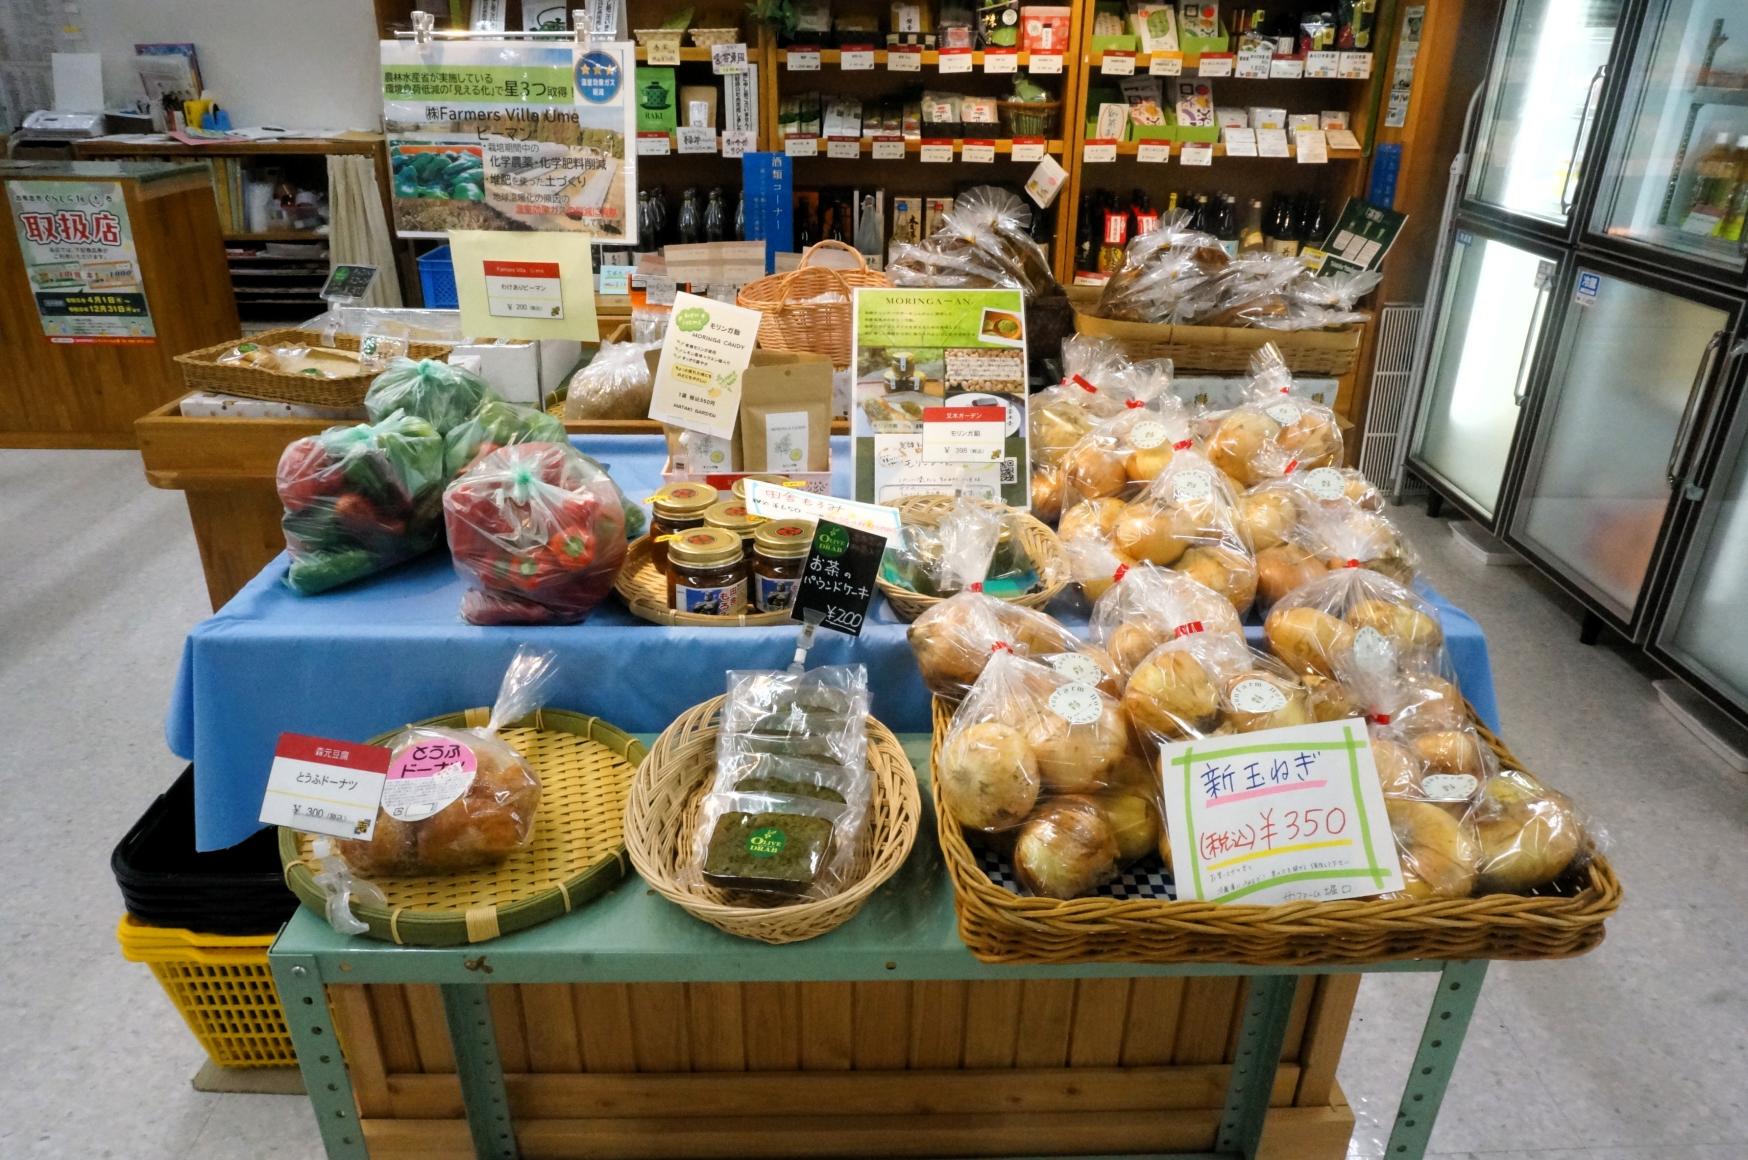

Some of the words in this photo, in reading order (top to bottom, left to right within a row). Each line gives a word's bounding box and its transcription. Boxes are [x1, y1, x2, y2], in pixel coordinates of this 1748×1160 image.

[385, 72, 493, 83] 農林水産省が実施している
[477, 126, 534, 141] ピーマン
[490, 155, 607, 170] 化学農薬・化学肥料削減
[23, 213, 119, 243] 取扱店
[501, 283, 546, 292] わけありピーマン
[692, 333, 721, 344] MORINGA
[723, 340, 745, 350] CANDY
[819, 533, 845, 546] OLIVE
[819, 543, 843, 553] DRAB
[810, 555, 852, 580] お茶の
[803, 575, 870, 600] パウンドケーキ
[826, 604, 863, 628] ¥200
[413, 744, 460, 761] とうふ
[296, 771, 359, 791] とうふドーナツ
[1201, 751, 1321, 799] 新玉ねぎ
[305, 807, 324, 818] 300
[749, 845, 778, 853] DRAB
[750, 836, 782, 848] OLIVE
